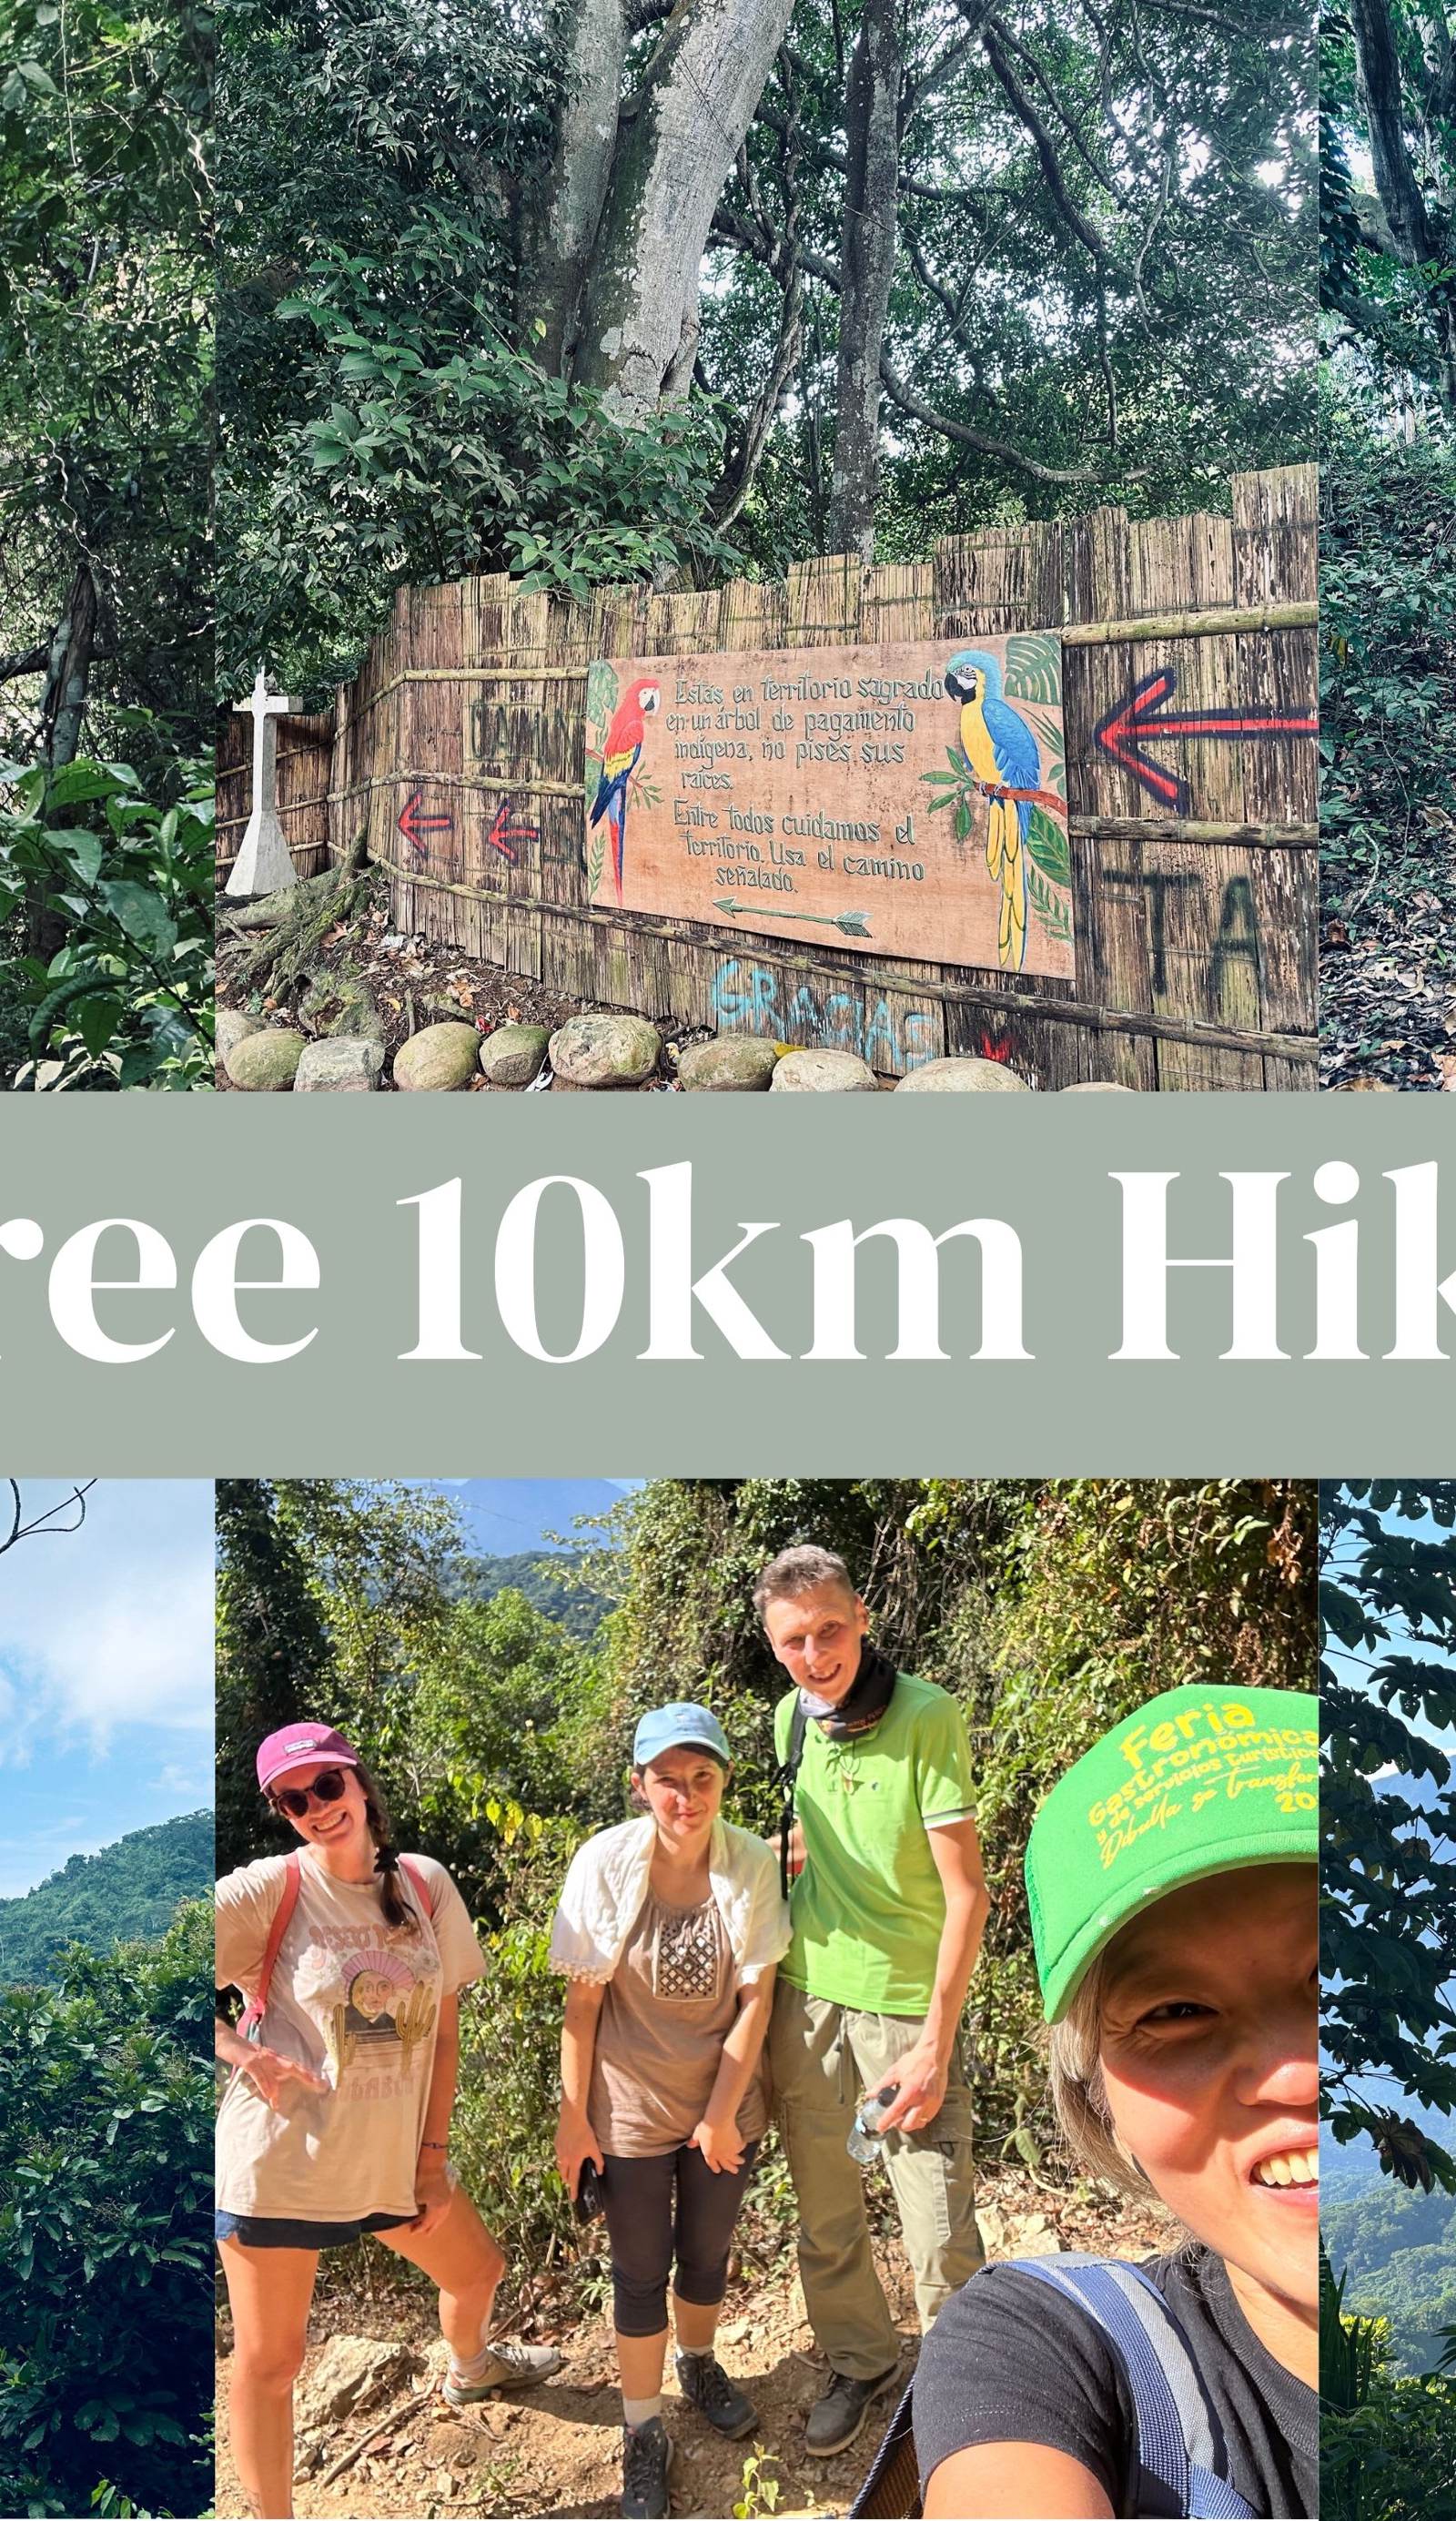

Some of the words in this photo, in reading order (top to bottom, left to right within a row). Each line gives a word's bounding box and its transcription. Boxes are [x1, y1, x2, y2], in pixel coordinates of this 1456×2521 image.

[674, 678, 723, 704] Estás
[733, 684, 754, 704] en
[760, 673, 853, 702] territorio
[856, 666, 945, 704] sagrado
[665, 713, 687, 731] en
[691, 713, 713, 731] un
[714, 704, 762, 731] árbol
[771, 704, 794, 732] de
[804, 702, 915, 742] pagamento
[762, 739, 786, 761] no
[795, 738, 853, 769] pises
[860, 740, 905, 764] sus
[681, 769, 734, 790] raíces.
[673, 797, 719, 829] Entre
[721, 802, 774, 835] todos
[782, 808, 881, 842] cuidamos
[895, 814, 916, 845] el
[679, 829, 765, 864] territorio.
[768, 839, 807, 867] Usa
[817, 843, 835, 871] el
[843, 854, 925, 881] camino
[714, 865, 799, 894] señalado.
[1120, 1703, 1256, 1769] Feria
